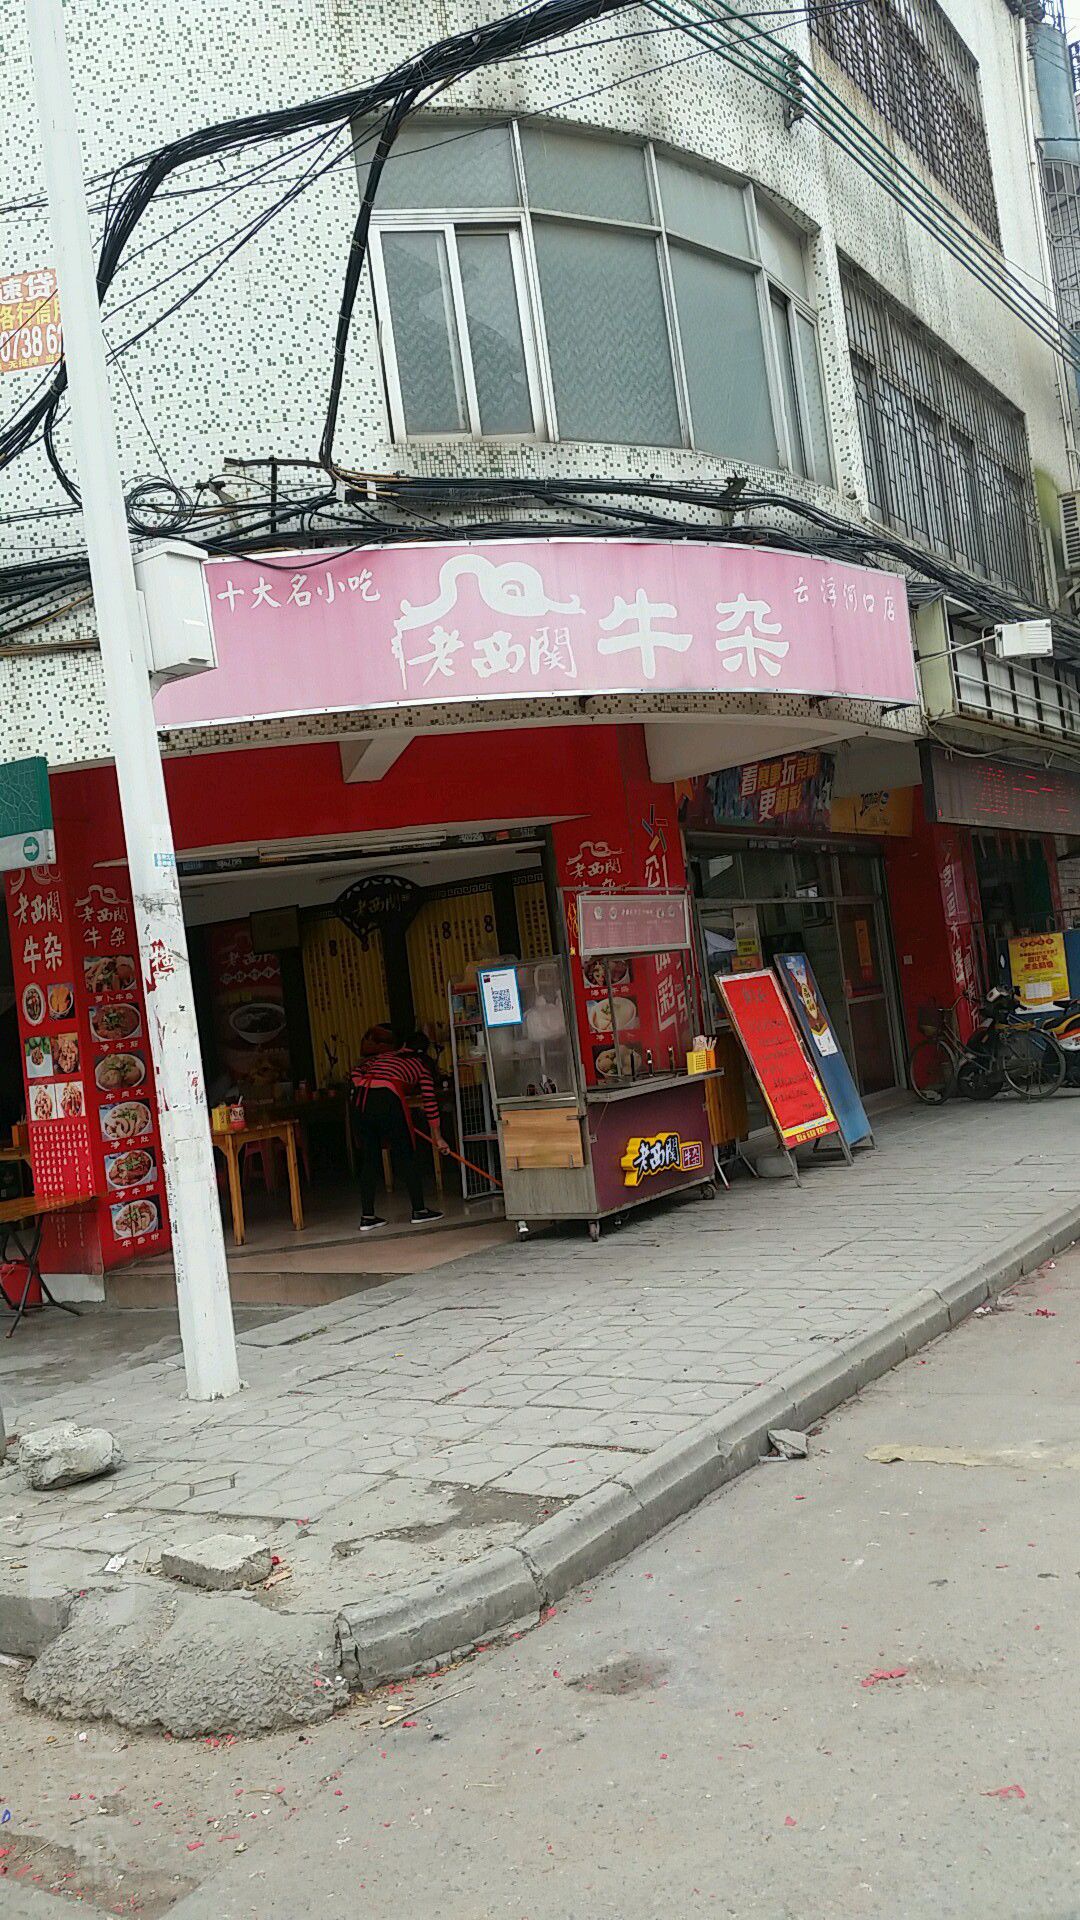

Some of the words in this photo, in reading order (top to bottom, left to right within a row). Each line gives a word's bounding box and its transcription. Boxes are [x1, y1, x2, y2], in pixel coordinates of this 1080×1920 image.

[217, 568, 381, 612] 十大名小吃
[793, 576, 895, 621] 云浮河口店
[597, 588, 789, 680] 牛杂
[23, 932, 63, 974] 牛杂
[83, 926, 126, 949] 牛杂
